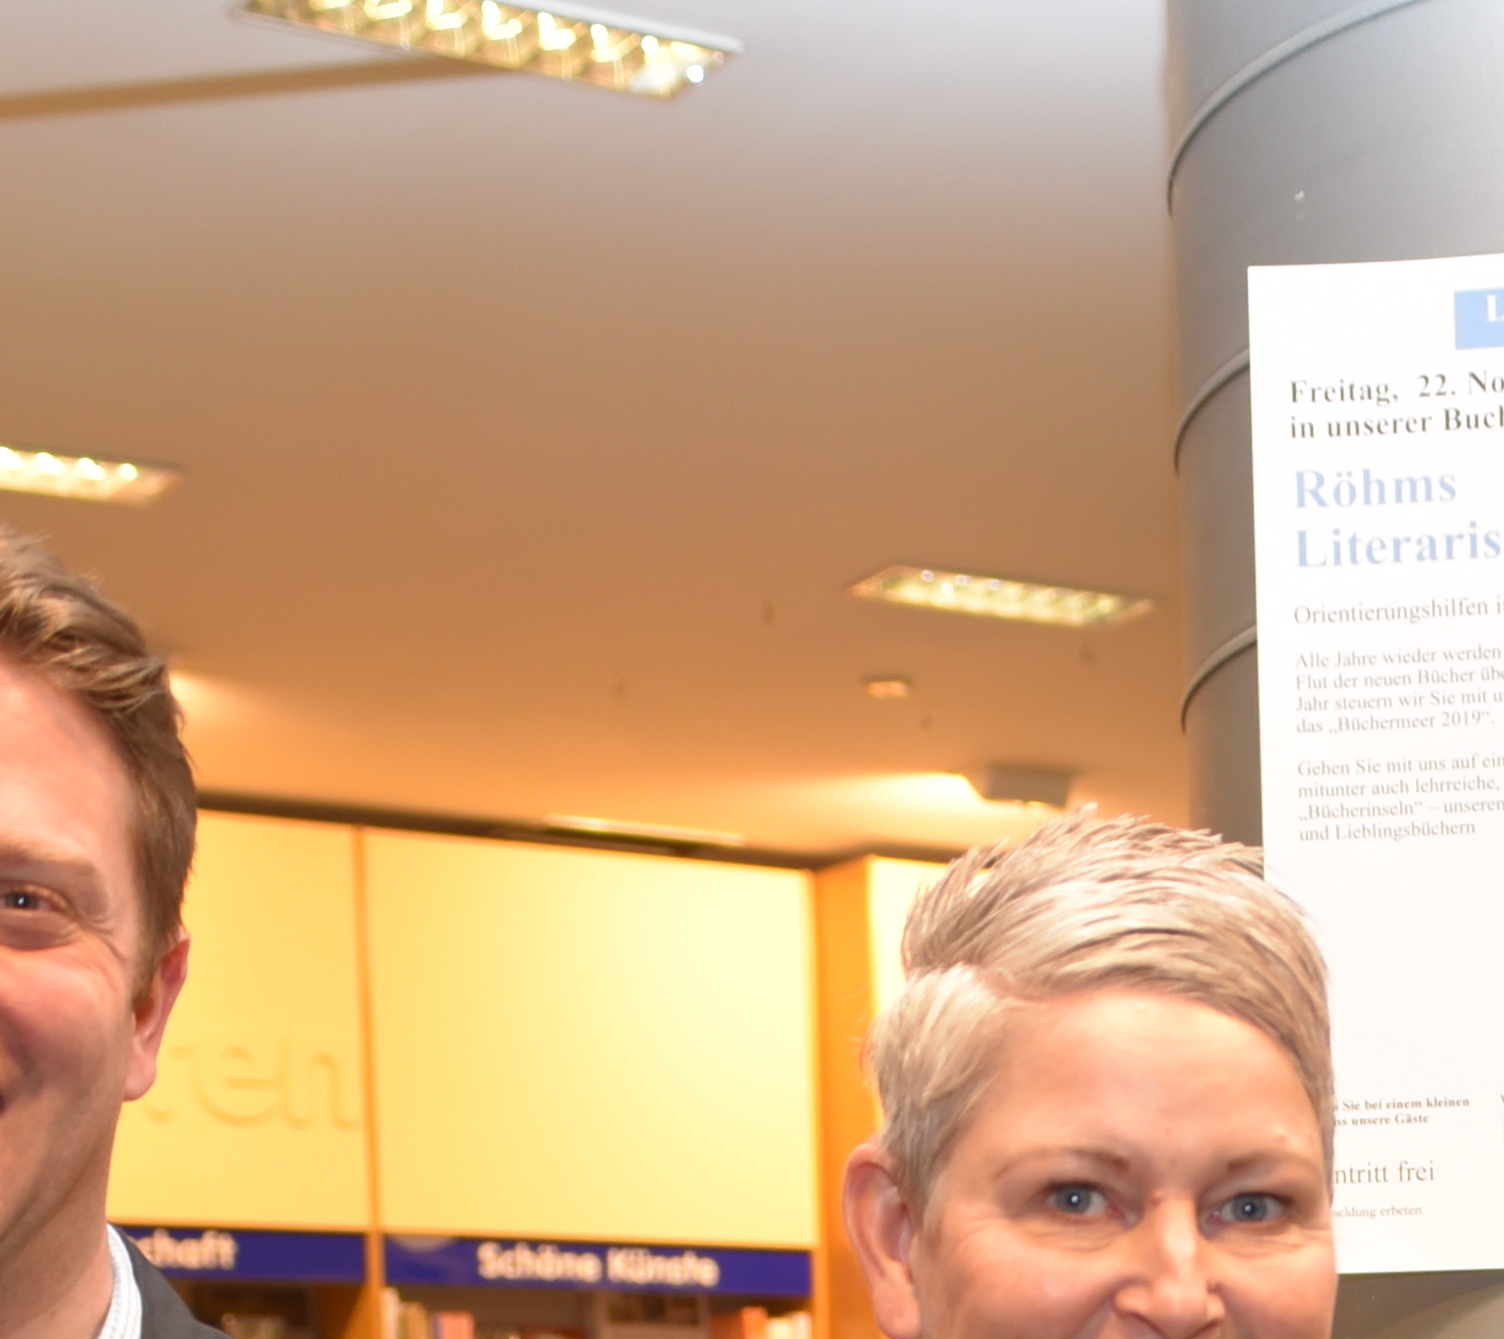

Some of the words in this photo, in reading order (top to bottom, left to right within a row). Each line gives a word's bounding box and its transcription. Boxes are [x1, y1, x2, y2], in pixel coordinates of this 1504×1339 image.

[1291, 380, 1398, 406] Freitag,
[1419, 374, 1455, 397] 22.
[1291, 417, 1314, 438] in
[1328, 416, 1431, 437] unserer
[1296, 468, 1456, 508] Röhms
[1294, 597, 1488, 624] Orientierungshilfen
[1335, 651, 1377, 667] Jahre
[1383, 647, 1437, 664] wieder
[1443, 644, 1501, 661] werden
[1364, 675, 1412, 687] neuen
[1418, 668, 1475, 684] Bücher
[1335, 697, 1393, 710] steuern
[1297, 760, 1350, 776] Gehen
[1298, 784, 1366, 798] mitunter
[1415, 775, 1500, 794] lehrreiche,
[1336, 820, 1476, 841] Lieblingsbüchern
[1343, 1101, 1360, 1111] Sie
[1364, 1100, 1382, 1110] bei
[1386, 1100, 1422, 1109] einem
[1426, 1097, 1470, 1107] kleinen
[1351, 1118, 1391, 1127] unsere
[1394, 1114, 1429, 1124] Gäste
[1335, 1161, 1388, 1184] ntritt
[1398, 1160, 1434, 1182] frei
[1380, 1205, 1422, 1216] erbeten
[136, 1228, 238, 1270] chaft
[477, 1241, 602, 1283] Schöne
[607, 1247, 720, 1287] Künste
